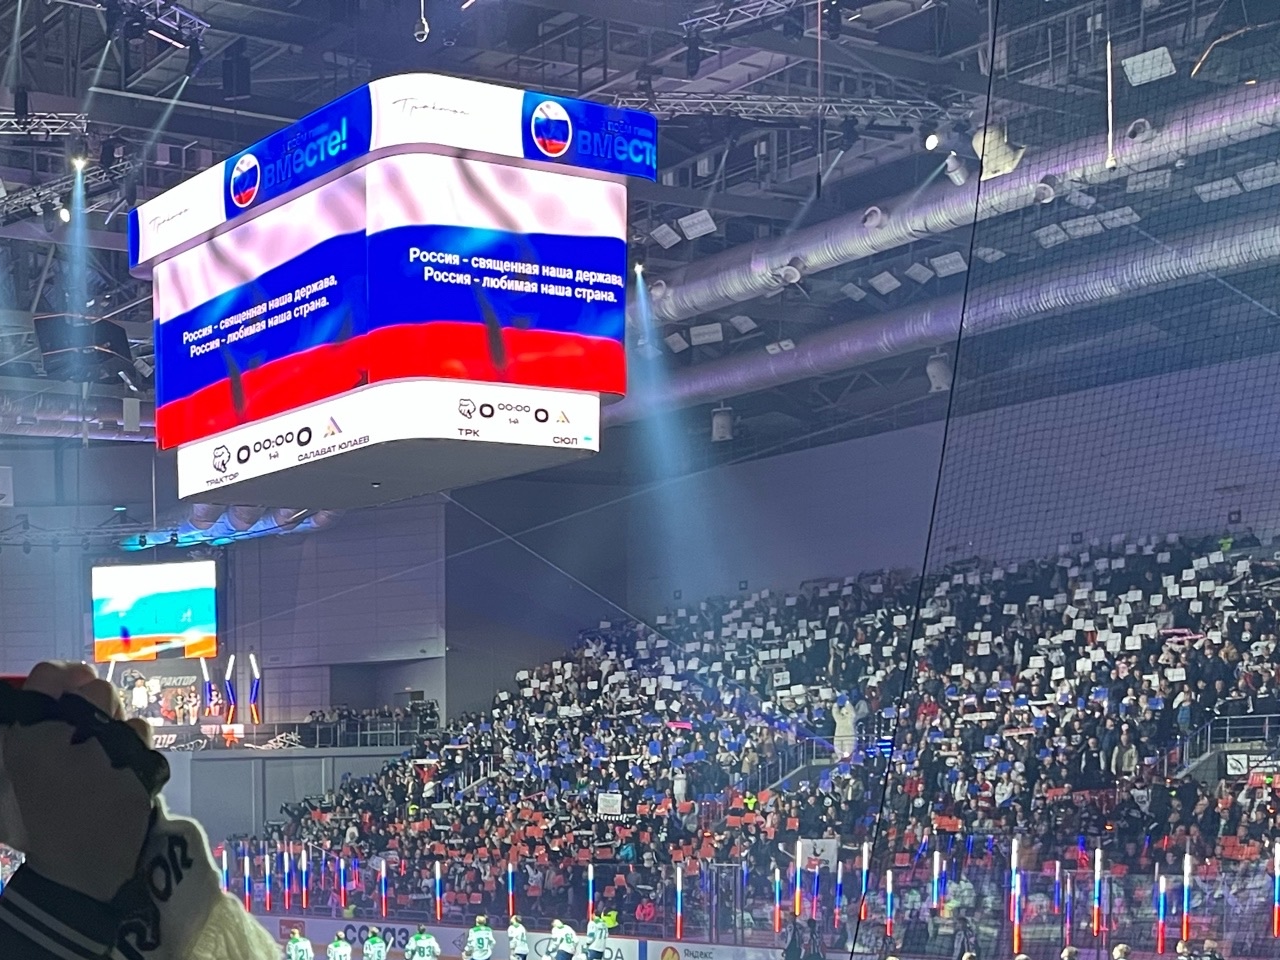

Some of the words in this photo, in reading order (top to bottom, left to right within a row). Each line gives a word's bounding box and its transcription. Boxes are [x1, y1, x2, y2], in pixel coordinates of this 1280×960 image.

[409, 248, 460, 265] Россия
[471, 256, 539, 275] священная
[542, 265, 573, 279] наша
[575, 270, 624, 288] держава,
[424, 267, 471, 285] Россия
[482, 275, 538, 293] любимая
[540, 283, 572, 297] наша
[575, 287, 617, 303] страна.
[183, 324, 213, 344] Россия
[220, 302, 267, 330] священная
[268, 294, 293, 311] наша
[294, 275, 338, 302] держава,
[190, 339, 220, 357] Россия
[227, 320, 266, 344] любимая
[268, 310, 292, 328] наша
[294, 297, 329, 317] страна.
[458, 428, 480, 437] ТРК
[553, 436, 578, 445] СЮЛ
[298, 445, 336, 462] САЛАВАТ
[338, 435, 370, 451] ЮЛАЕВ
[206, 472, 239, 486] ТРАКТОР
[684, 949, 713, 960] Яндекс
